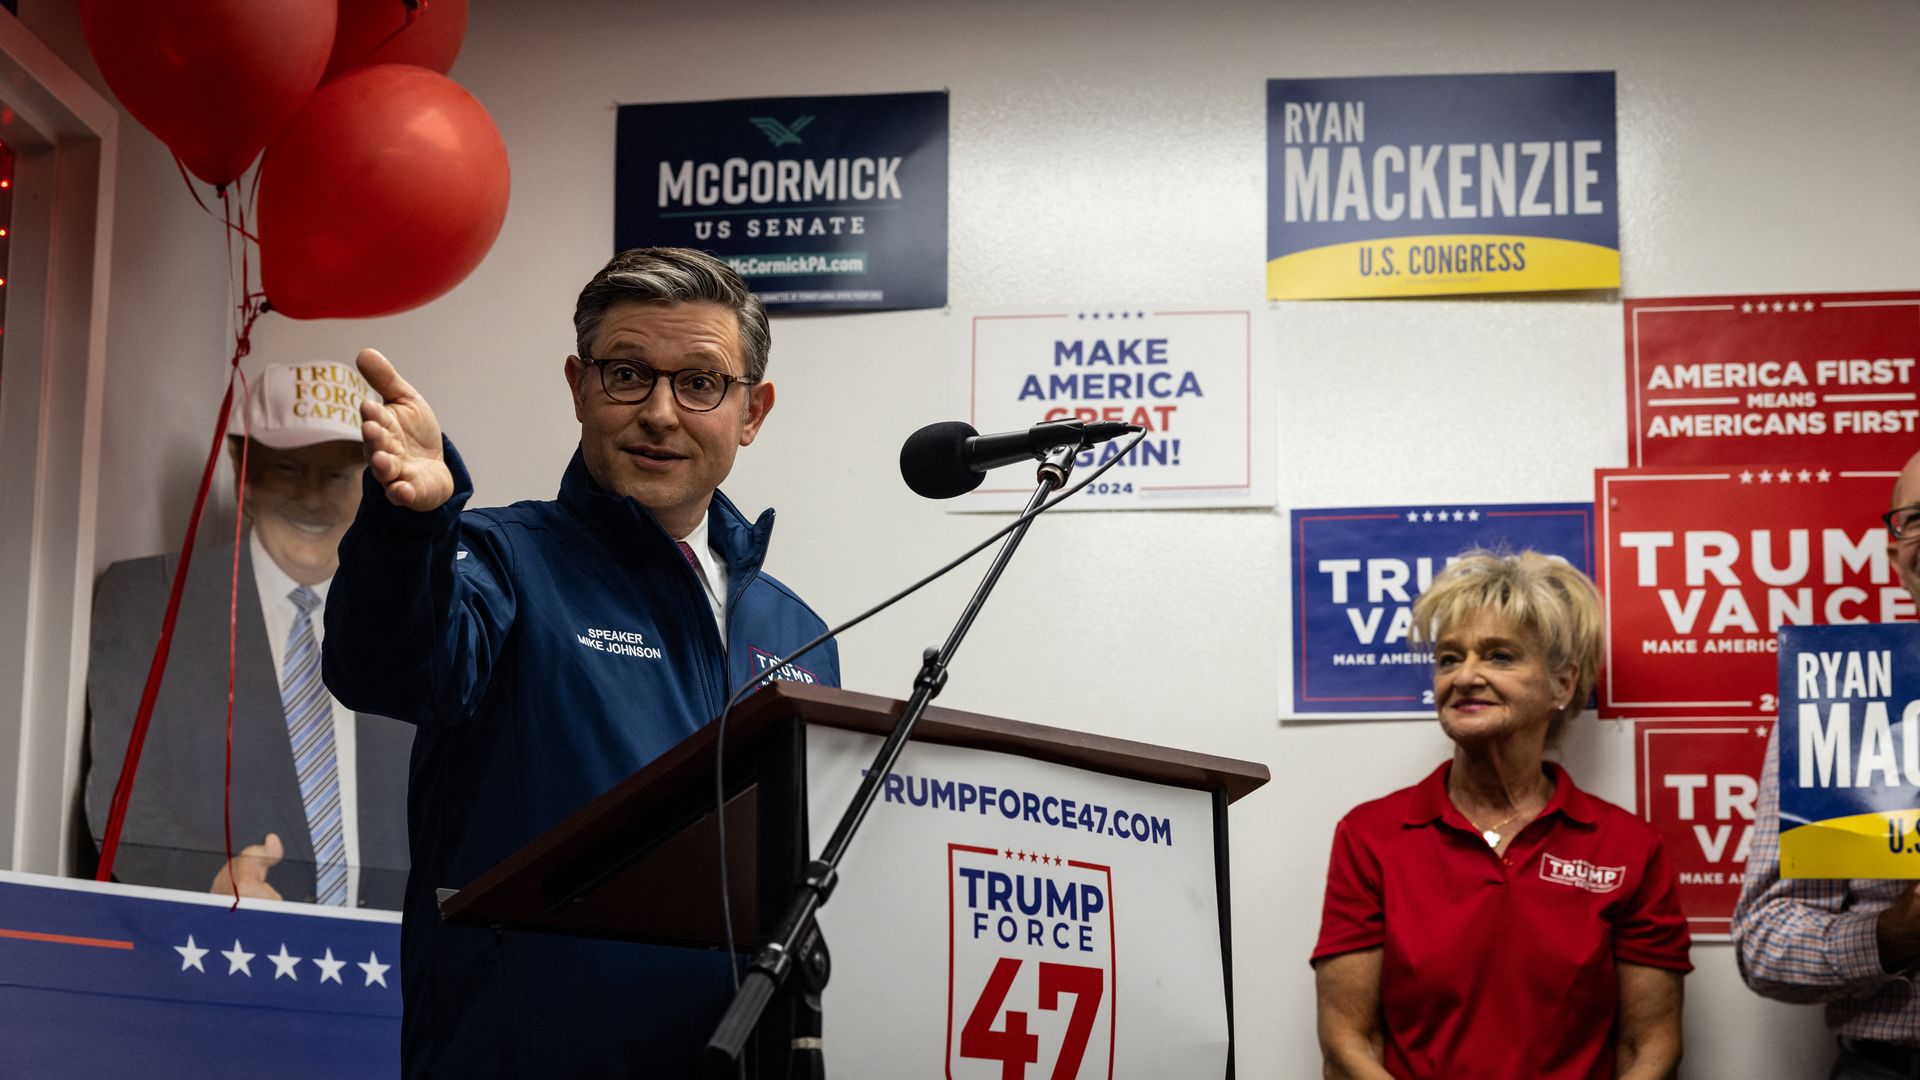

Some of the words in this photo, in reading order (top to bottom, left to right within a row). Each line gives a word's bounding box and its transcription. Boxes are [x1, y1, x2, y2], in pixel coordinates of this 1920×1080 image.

[1284, 102, 1364, 144] RYAN
[1284, 140, 1603, 223] MACKENZIE
[694, 220, 731, 239] US
[747, 216, 866, 238] SENATE
[1359, 246, 1400, 276] U.S.
[1409, 242, 1526, 275] CONGRESS
[1054, 338, 1168, 367] MAKE
[1017, 371, 1204, 401] AMERICA
[1647, 360, 1809, 390] AMERICA
[1816, 357, 1916, 386] FIRST
[1746, 392, 1818, 409] MEANS
[1647, 411, 1827, 438] AMERICANS
[1833, 409, 1919, 434] FIRST
[1074, 439, 1181, 468] GAIN!
[1086, 482, 1134, 495] 2024
[1619, 528, 1891, 588] TRUM
[577, 633, 604, 651] MIKE
[606, 641, 662, 659] JOHNSON
[588, 627, 643, 645] SPEAKER
[1642, 638, 1698, 655] MAKE
[1703, 637, 1778, 654] AMERIC
[1333, 653, 1376, 666] MAKE
[1380, 652, 1436, 665] AMERIC
[1797, 650, 1892, 699] RYAN
[861, 768, 1173, 846] RUMPFORCE47.COM
[1549, 859, 1617, 884] TRUMP
[1679, 872, 1724, 885] MAKE
[959, 866, 1104, 922] TRUMP
[973, 912, 1094, 952] FORCE
[959, 956, 1104, 1080] 47
